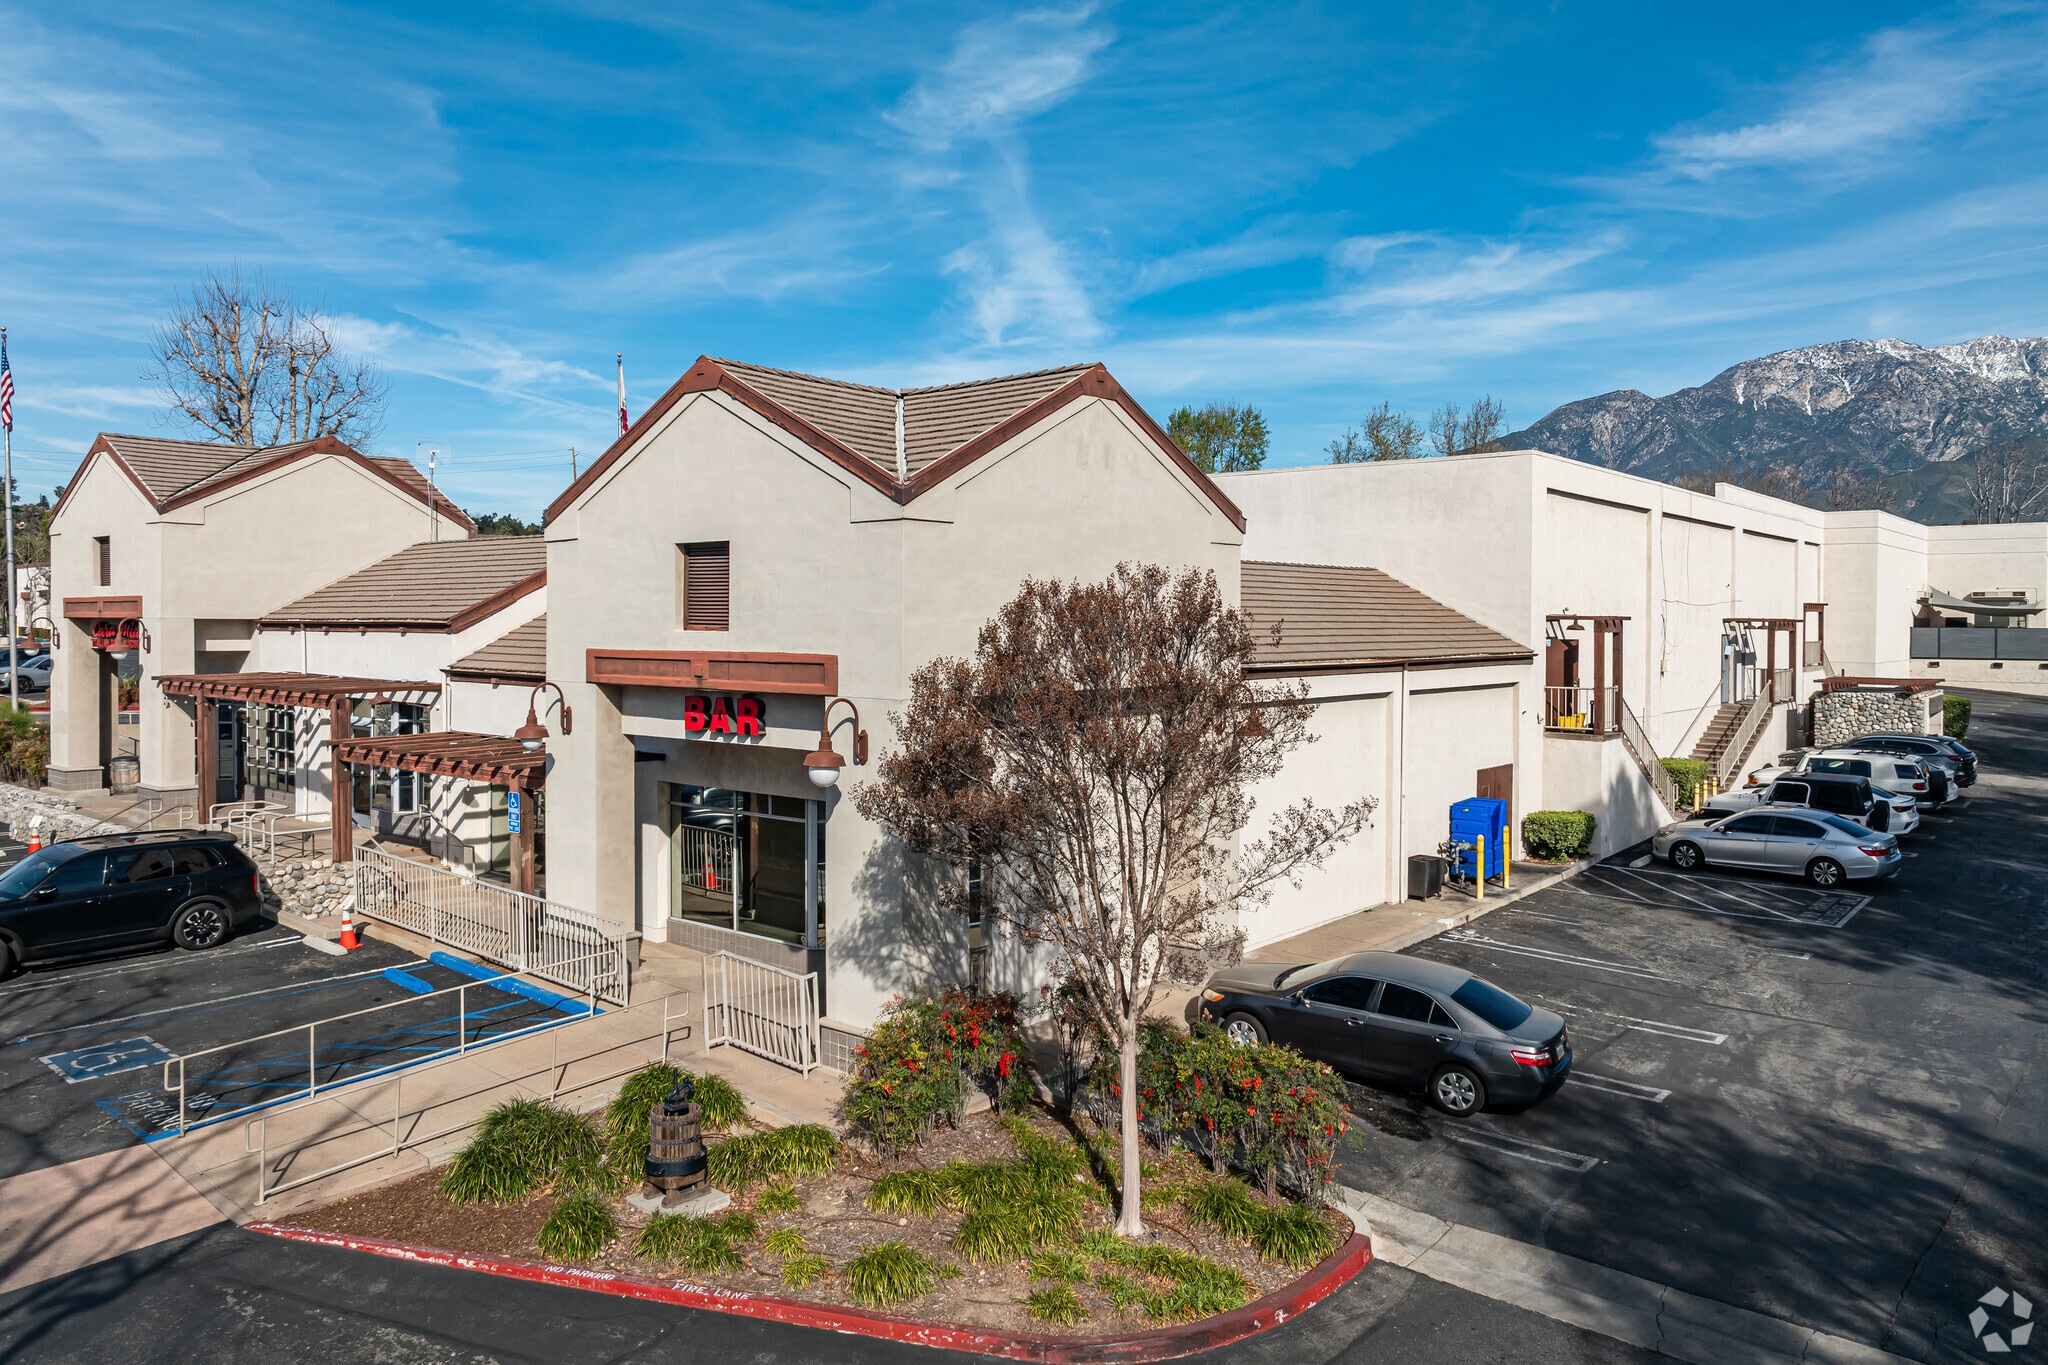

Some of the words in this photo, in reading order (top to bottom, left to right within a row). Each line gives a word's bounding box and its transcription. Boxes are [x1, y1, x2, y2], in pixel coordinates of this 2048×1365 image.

[684, 695, 760, 737] BAR
[545, 1265, 564, 1273] NO
[566, 1267, 616, 1281] PARKING
[672, 1282, 706, 1295] FIRE
[713, 1287, 753, 1300] LANE
